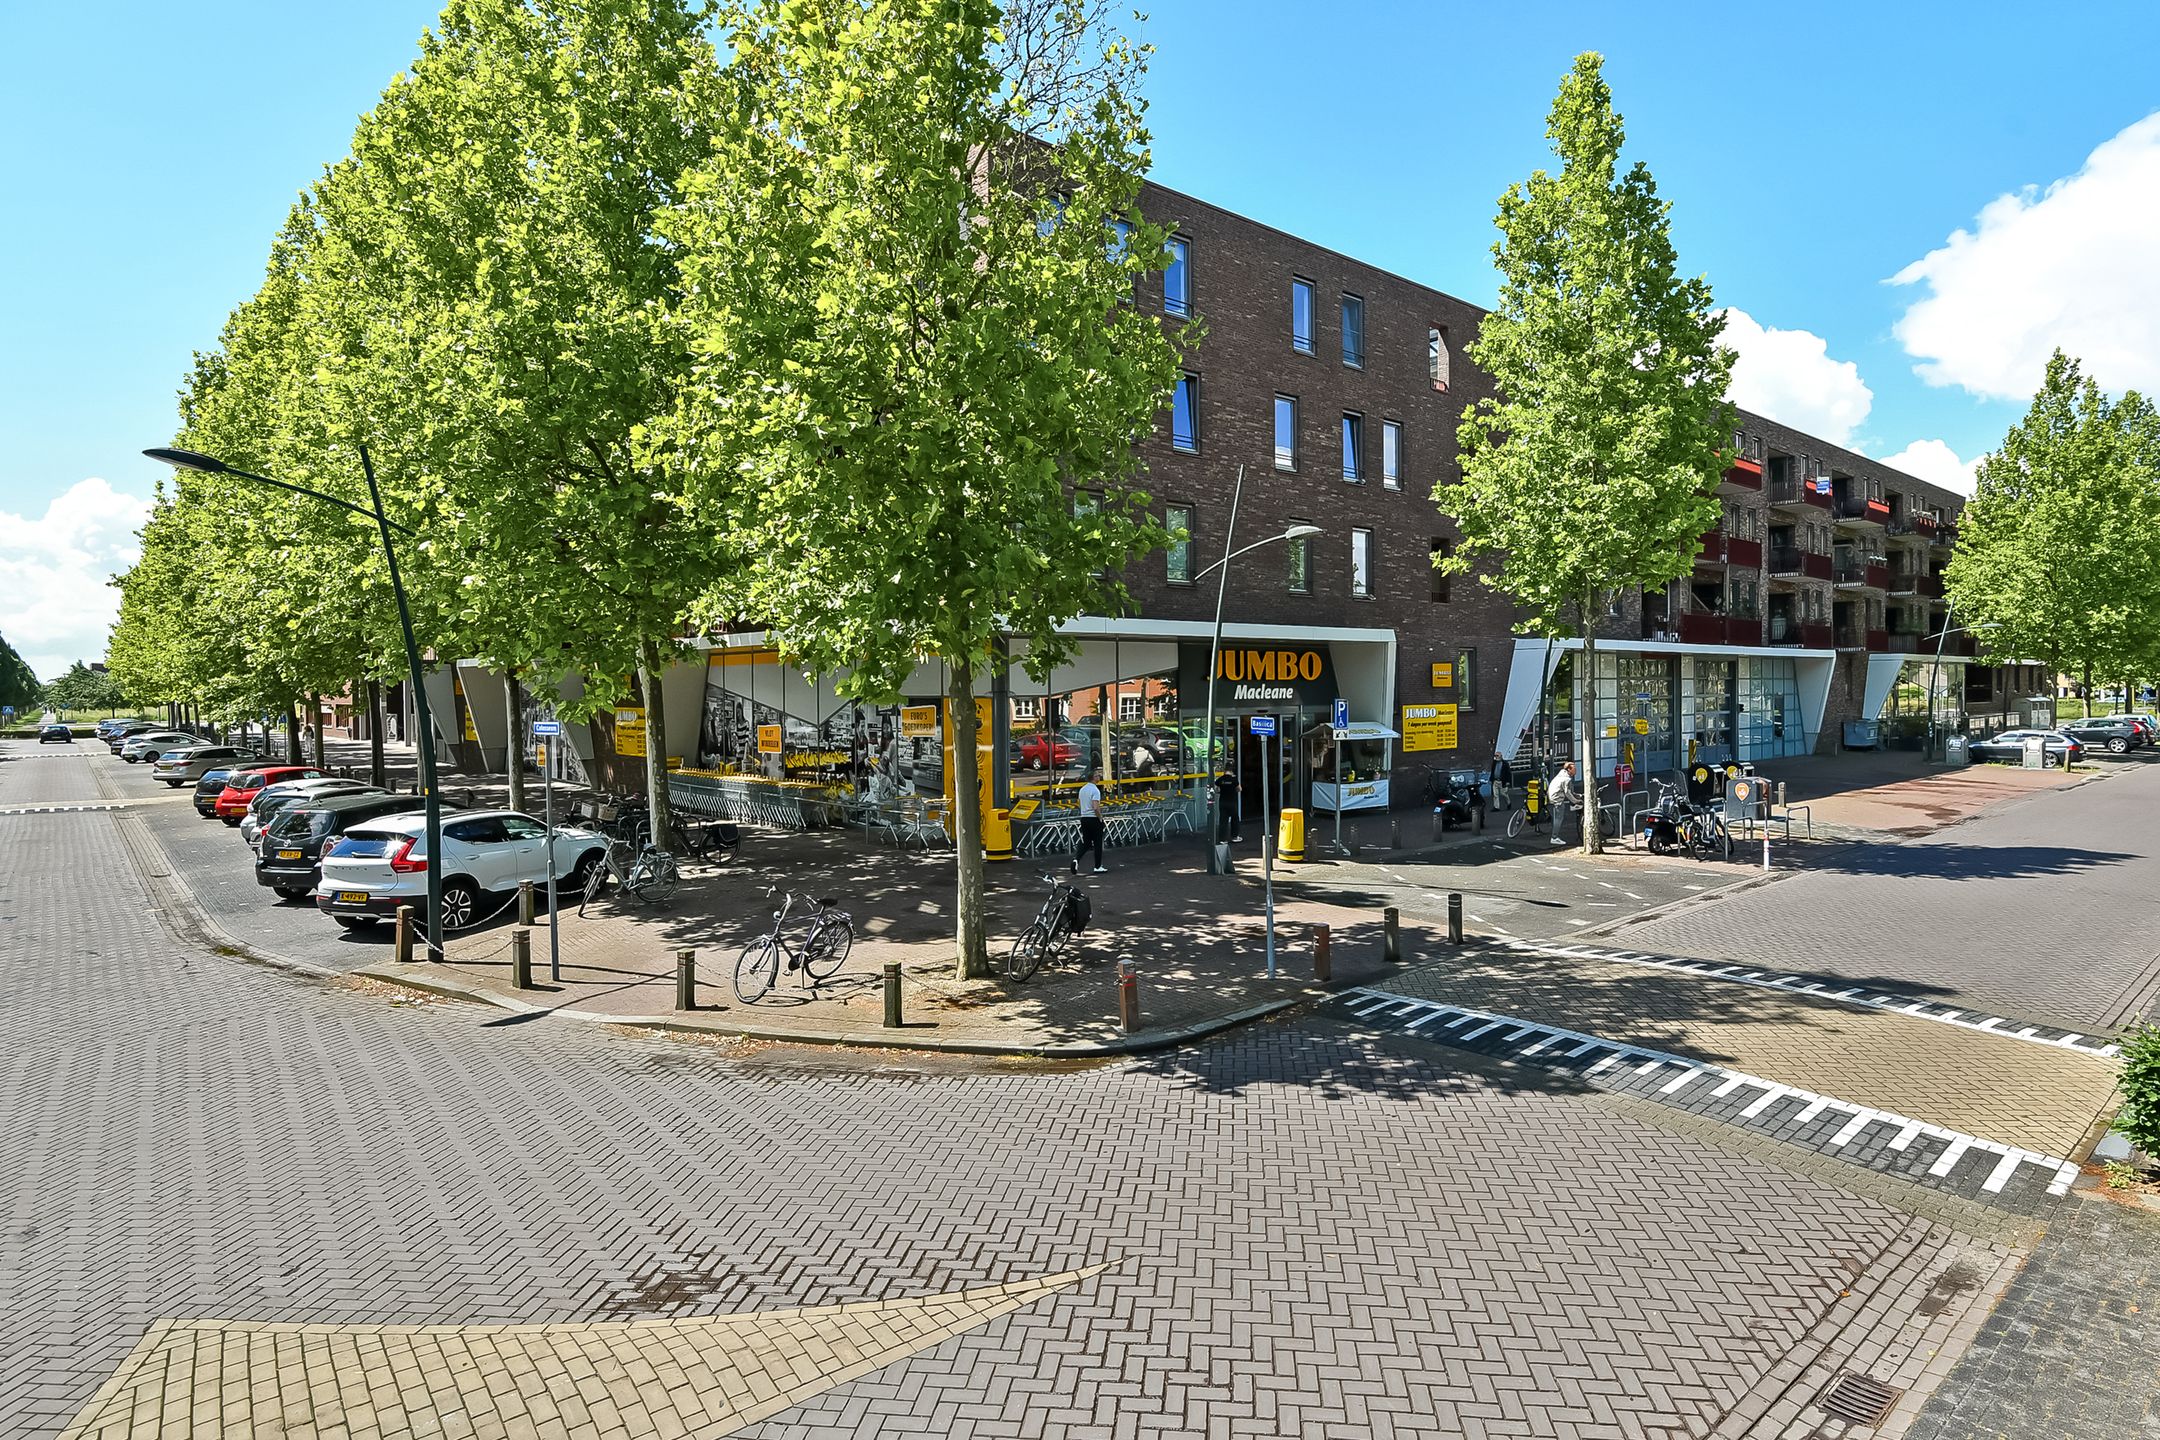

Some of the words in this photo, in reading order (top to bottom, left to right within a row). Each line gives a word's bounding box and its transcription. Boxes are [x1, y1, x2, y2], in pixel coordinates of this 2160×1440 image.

[1208, 650, 1322, 681] JUMBO
[1234, 683, 1294, 700] Macleane
[616, 710, 637, 721] JUMBO
[1338, 701, 1346, 717] P
[1405, 707, 1436, 718] JUMBO
[1252, 720, 1273, 728] Basilica
